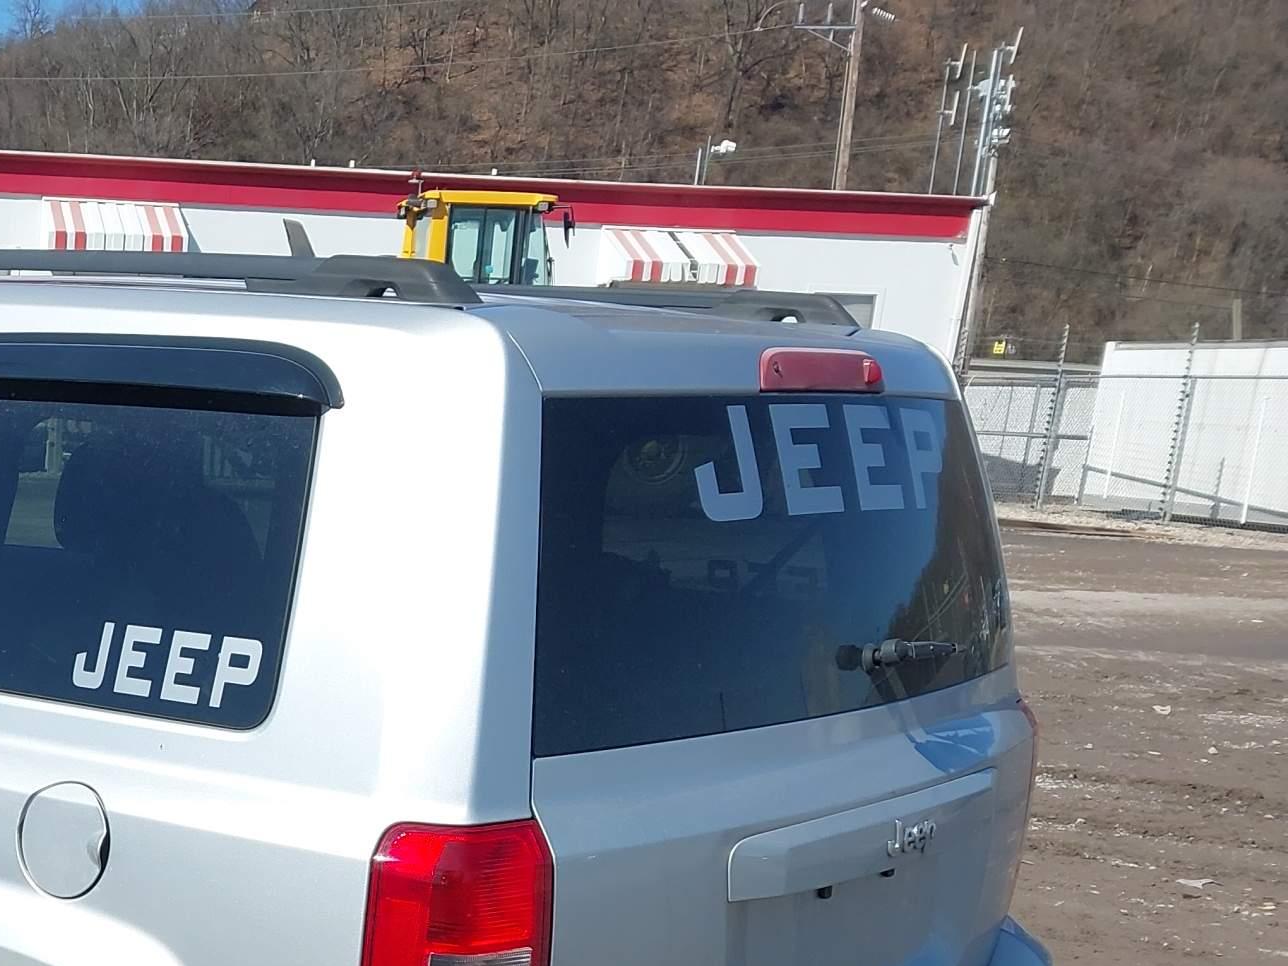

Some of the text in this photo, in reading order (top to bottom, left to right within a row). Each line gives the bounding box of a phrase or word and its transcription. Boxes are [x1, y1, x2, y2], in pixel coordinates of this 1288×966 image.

[694, 403, 944, 522] JEEP
[72, 621, 263, 708] JEEP
[887, 818, 937, 857] Jeep
